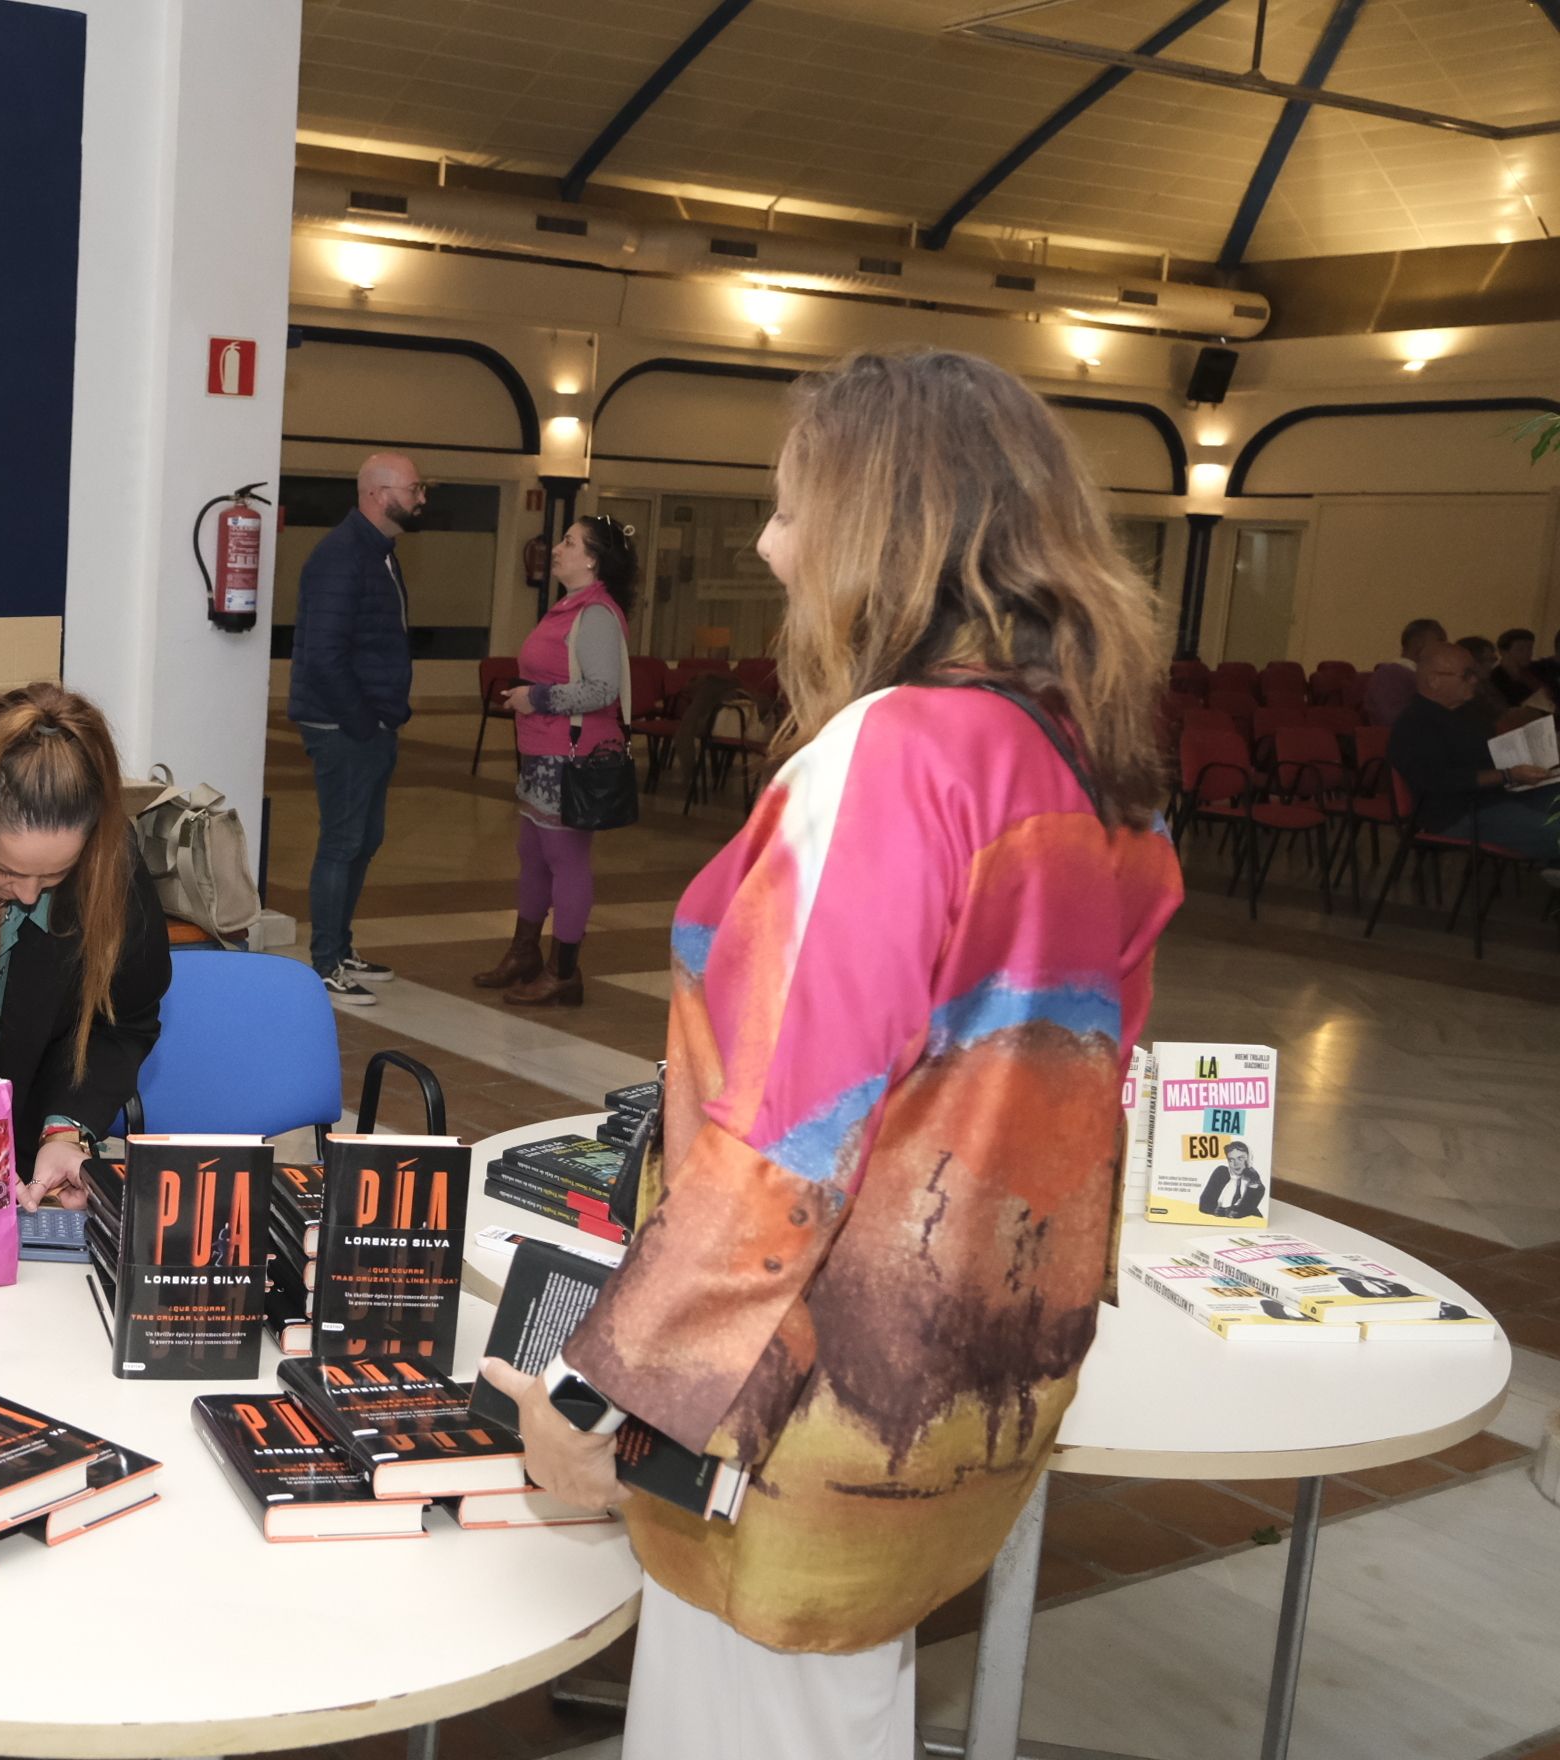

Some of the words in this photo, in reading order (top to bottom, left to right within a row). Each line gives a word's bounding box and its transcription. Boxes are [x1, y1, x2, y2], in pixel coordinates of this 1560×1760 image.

[1199, 1056, 1218, 1079] LA
[1166, 1081, 1266, 1107] MATERNIDAD
[1211, 1109, 1241, 1134] ERA
[1189, 1135, 1219, 1159] ESO
[355, 1157, 448, 1230] PÚA
[154, 1157, 251, 1268] PÚA
[345, 1236, 407, 1247] LORENZO
[412, 1238, 450, 1248] SILVA
[144, 1275, 208, 1285] LORENZO
[213, 1275, 251, 1285] SILVA
[331, 1385, 398, 1395] LORENZO
[254, 1447, 324, 1455] LORENZO
